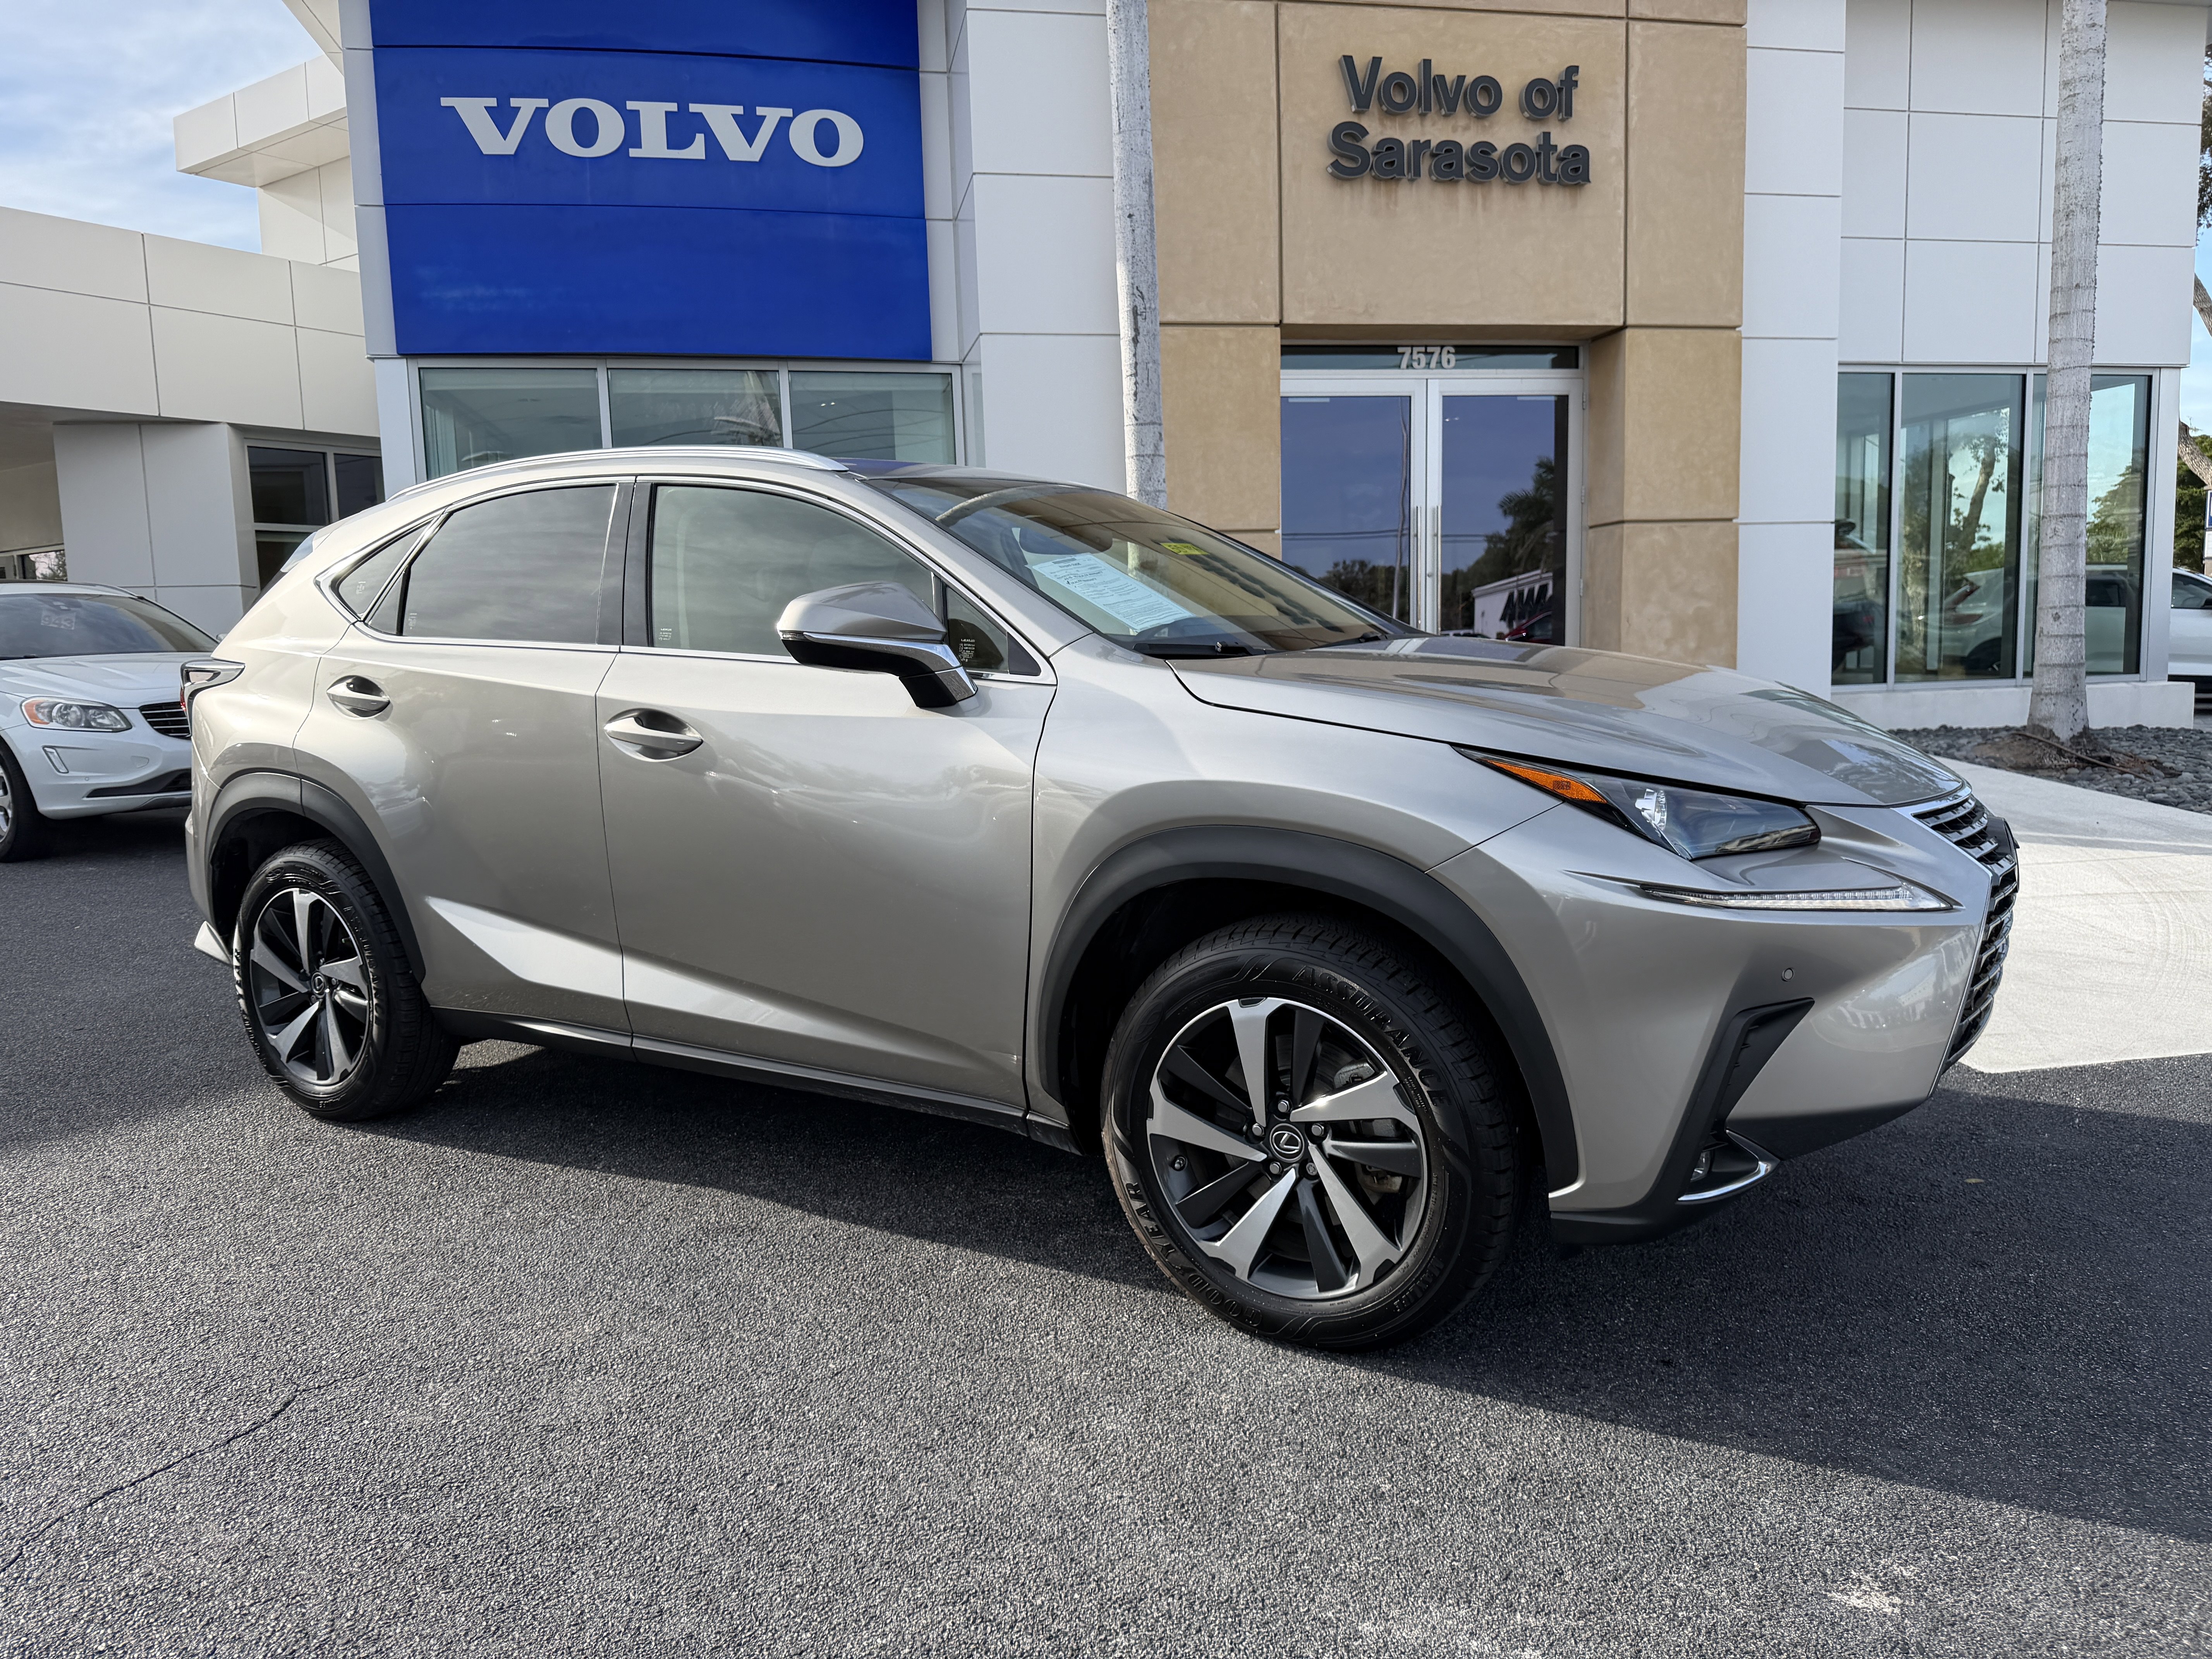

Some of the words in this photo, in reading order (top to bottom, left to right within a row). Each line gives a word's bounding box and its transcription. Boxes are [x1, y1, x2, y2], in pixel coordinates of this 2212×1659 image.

[1338, 55, 1503, 118] Volvo
[1518, 65, 1579, 121] of
[440, 97, 864, 167] VOLVO
[1326, 121, 1591, 185] Sarasota
[1397, 346, 1456, 369] 7576
[1292, 964, 1451, 1107] ASSURANCE
